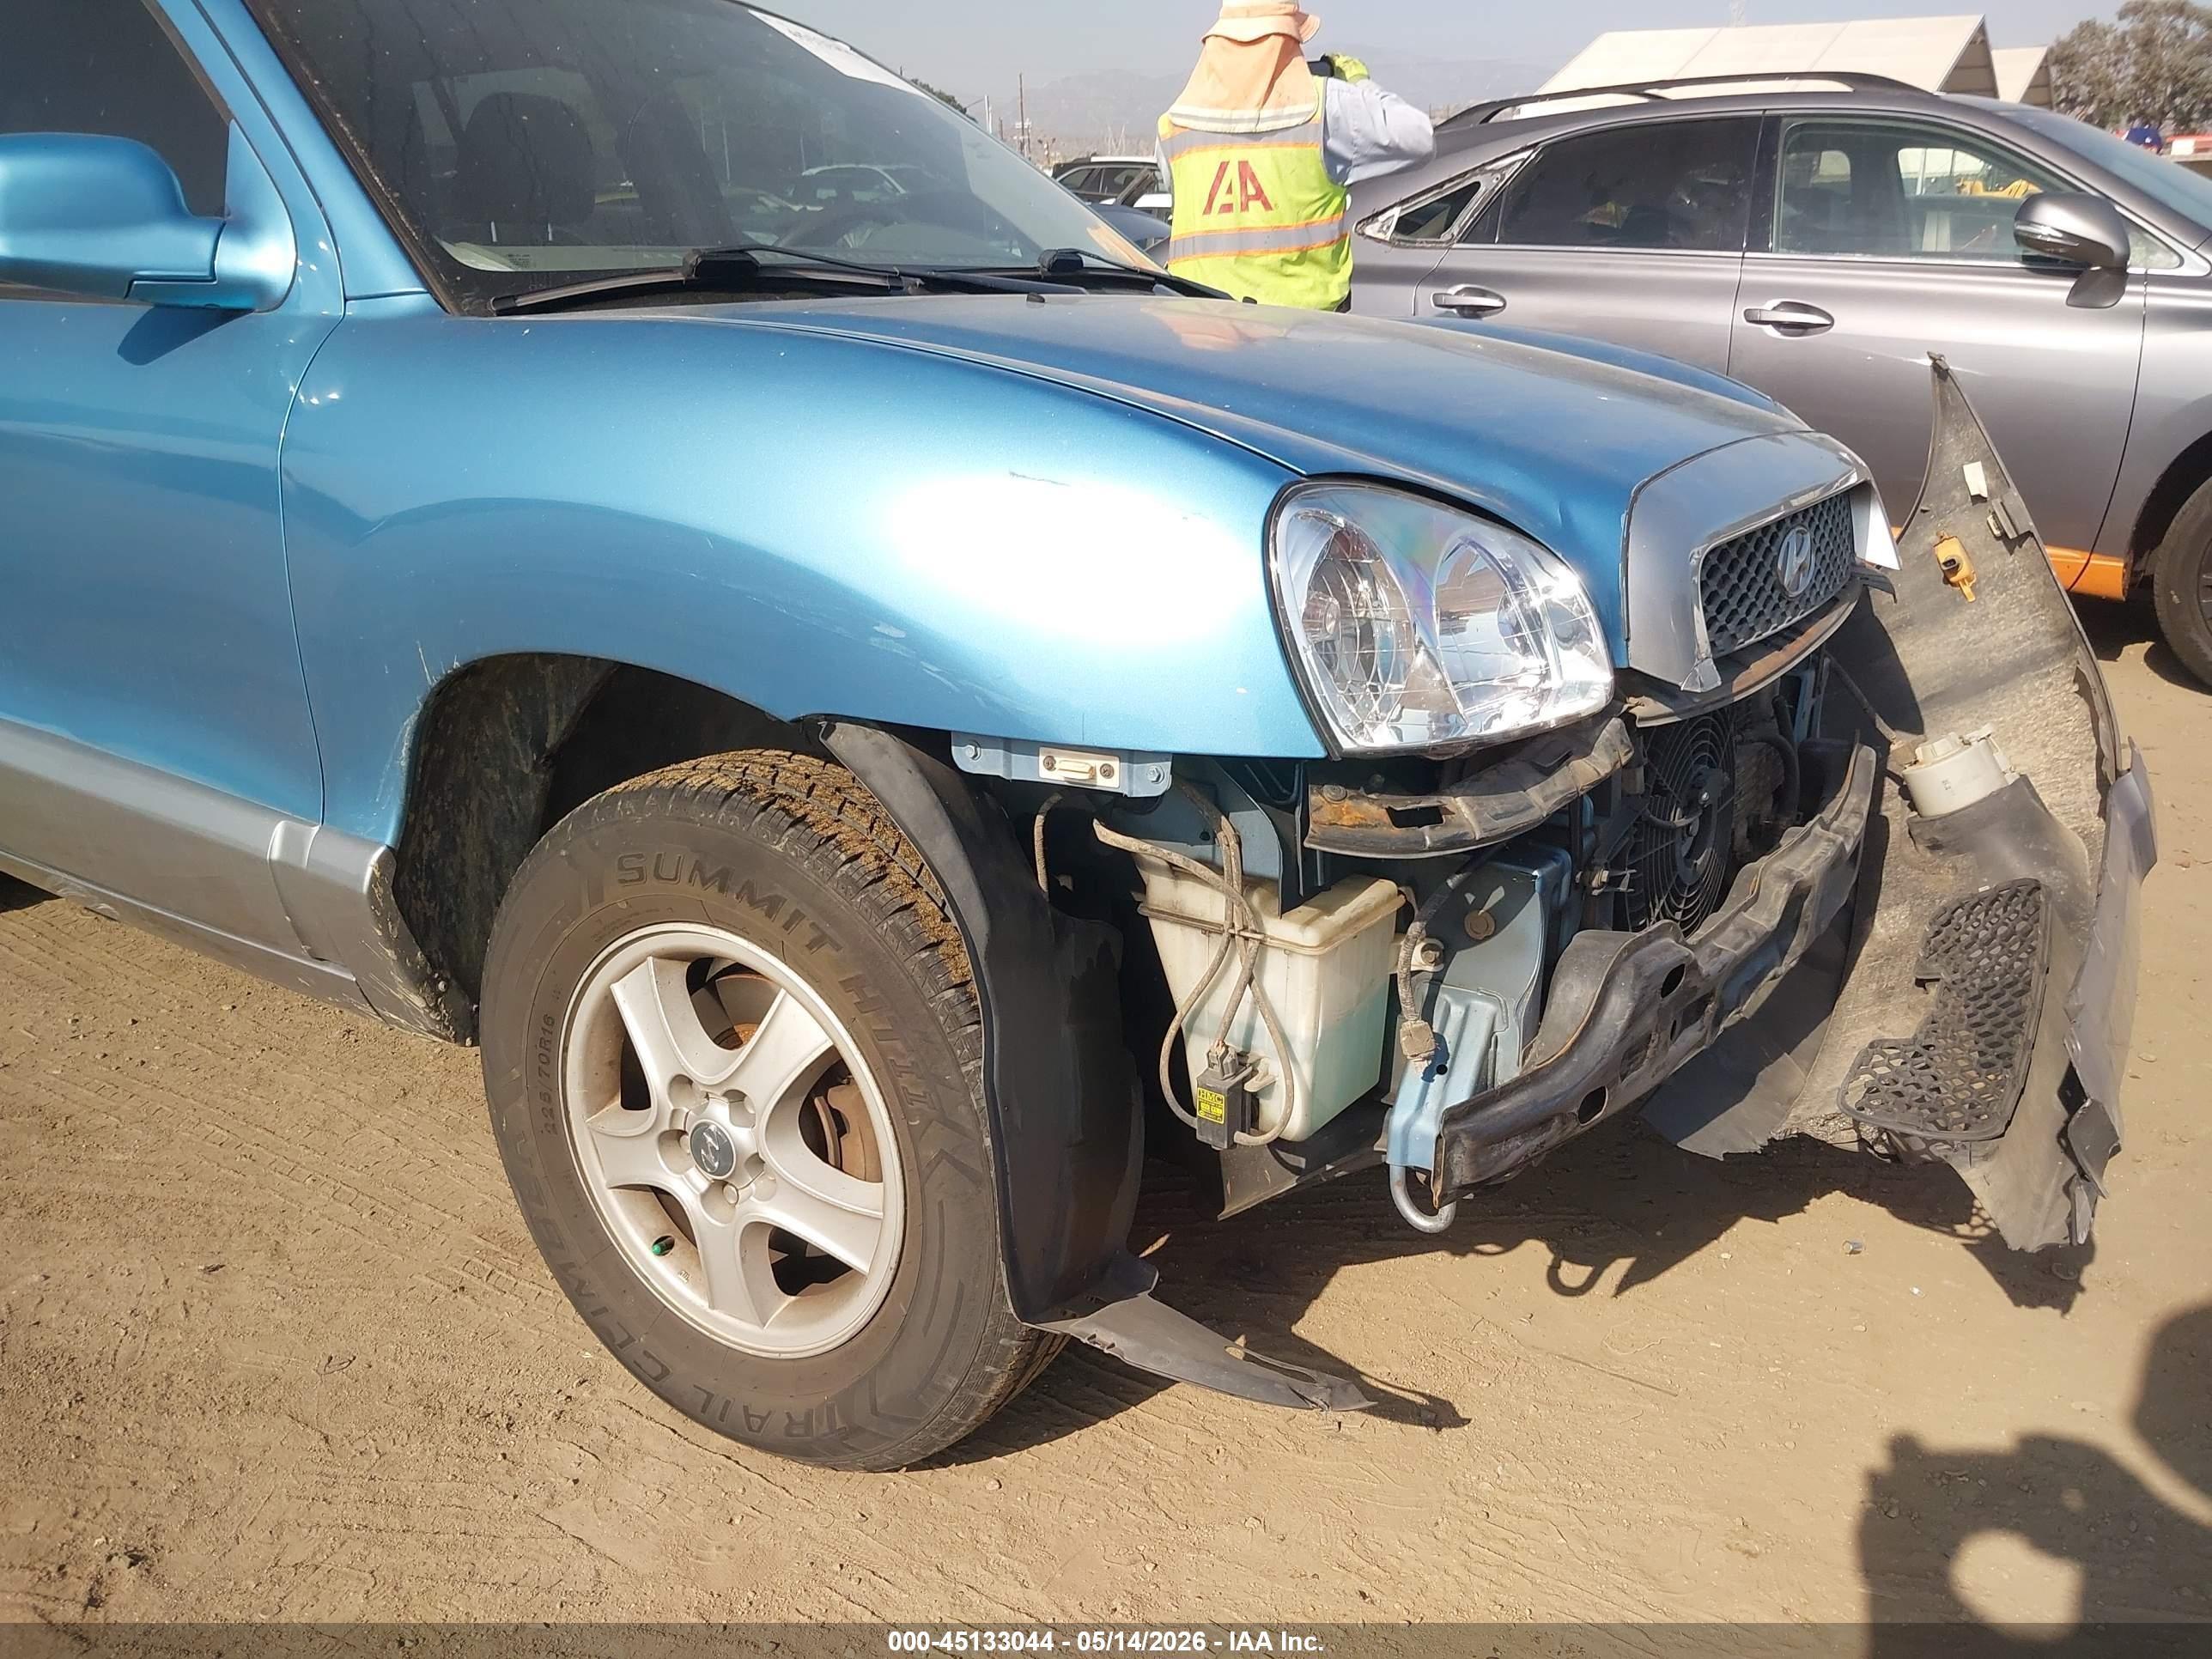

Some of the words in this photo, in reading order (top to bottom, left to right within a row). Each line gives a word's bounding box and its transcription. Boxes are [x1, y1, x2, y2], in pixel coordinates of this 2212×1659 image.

[617, 851, 843, 956] SUMMIT
[1199, 1090, 1224, 1103] HMC
[692, 1383, 849, 1441] TRAIL
